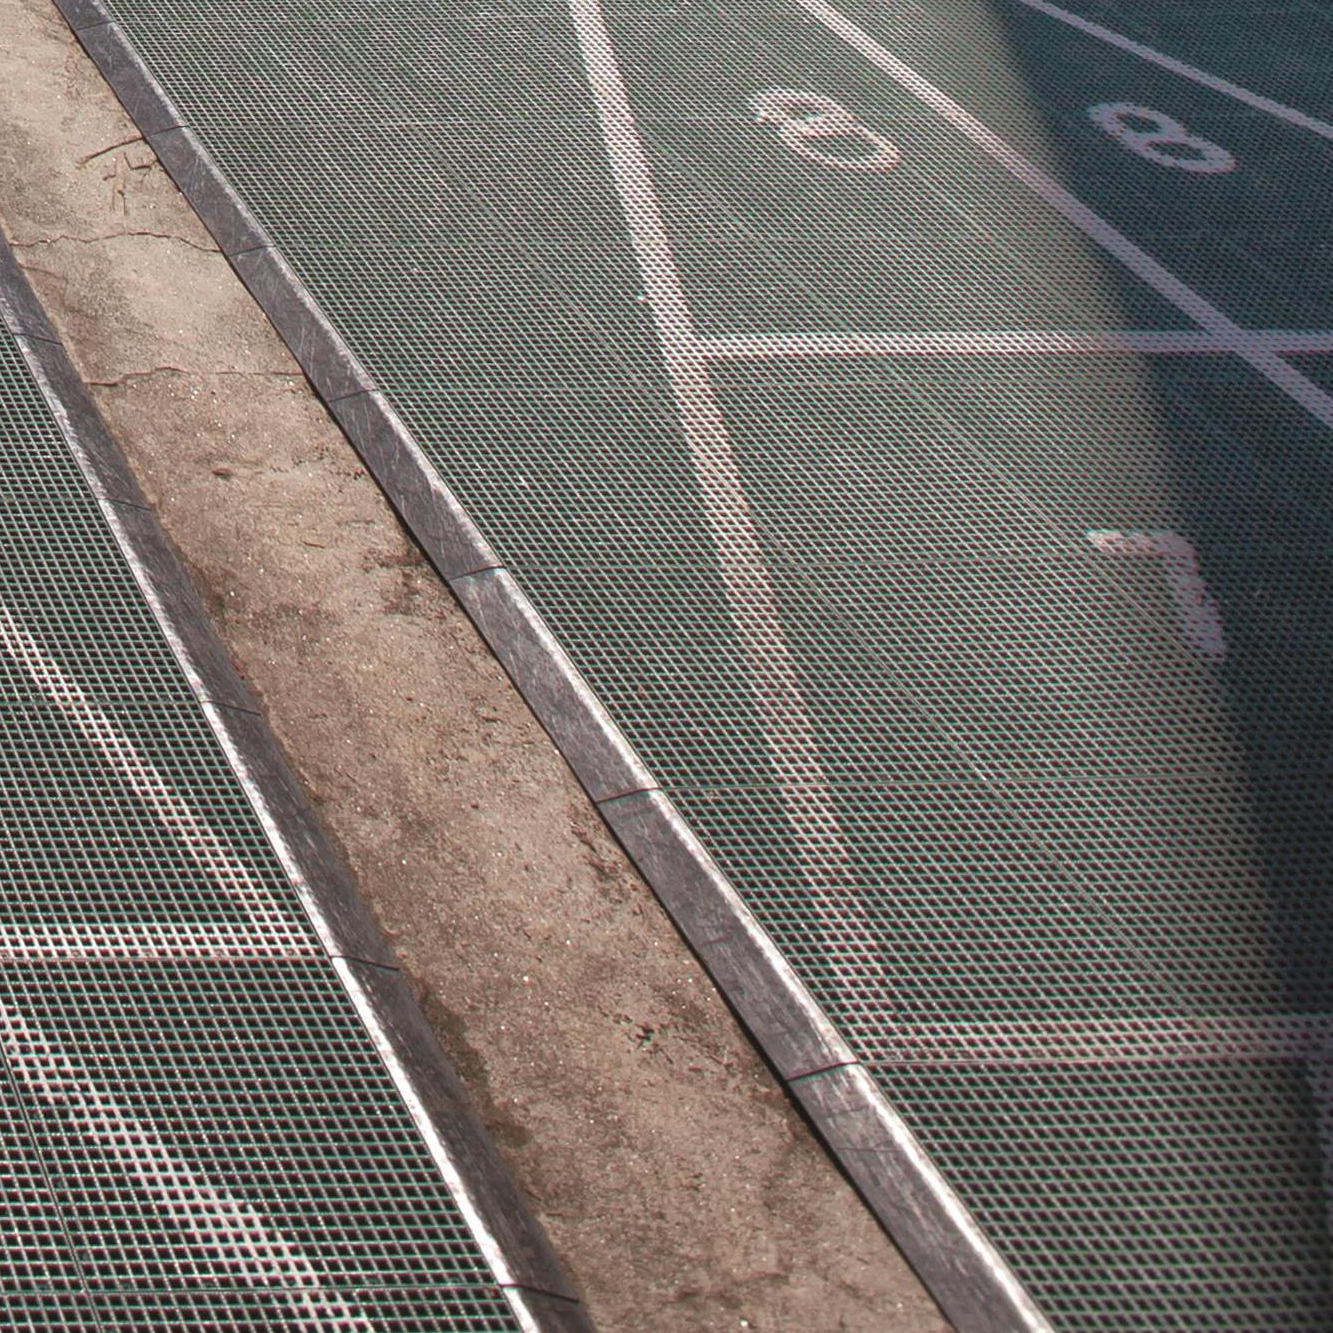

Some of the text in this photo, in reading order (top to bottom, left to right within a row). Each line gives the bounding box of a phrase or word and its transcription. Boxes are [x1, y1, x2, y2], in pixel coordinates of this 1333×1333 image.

[746, 87, 902, 172] 8
[1087, 101, 1237, 174] 8
[1086, 529, 1227, 663] 7
